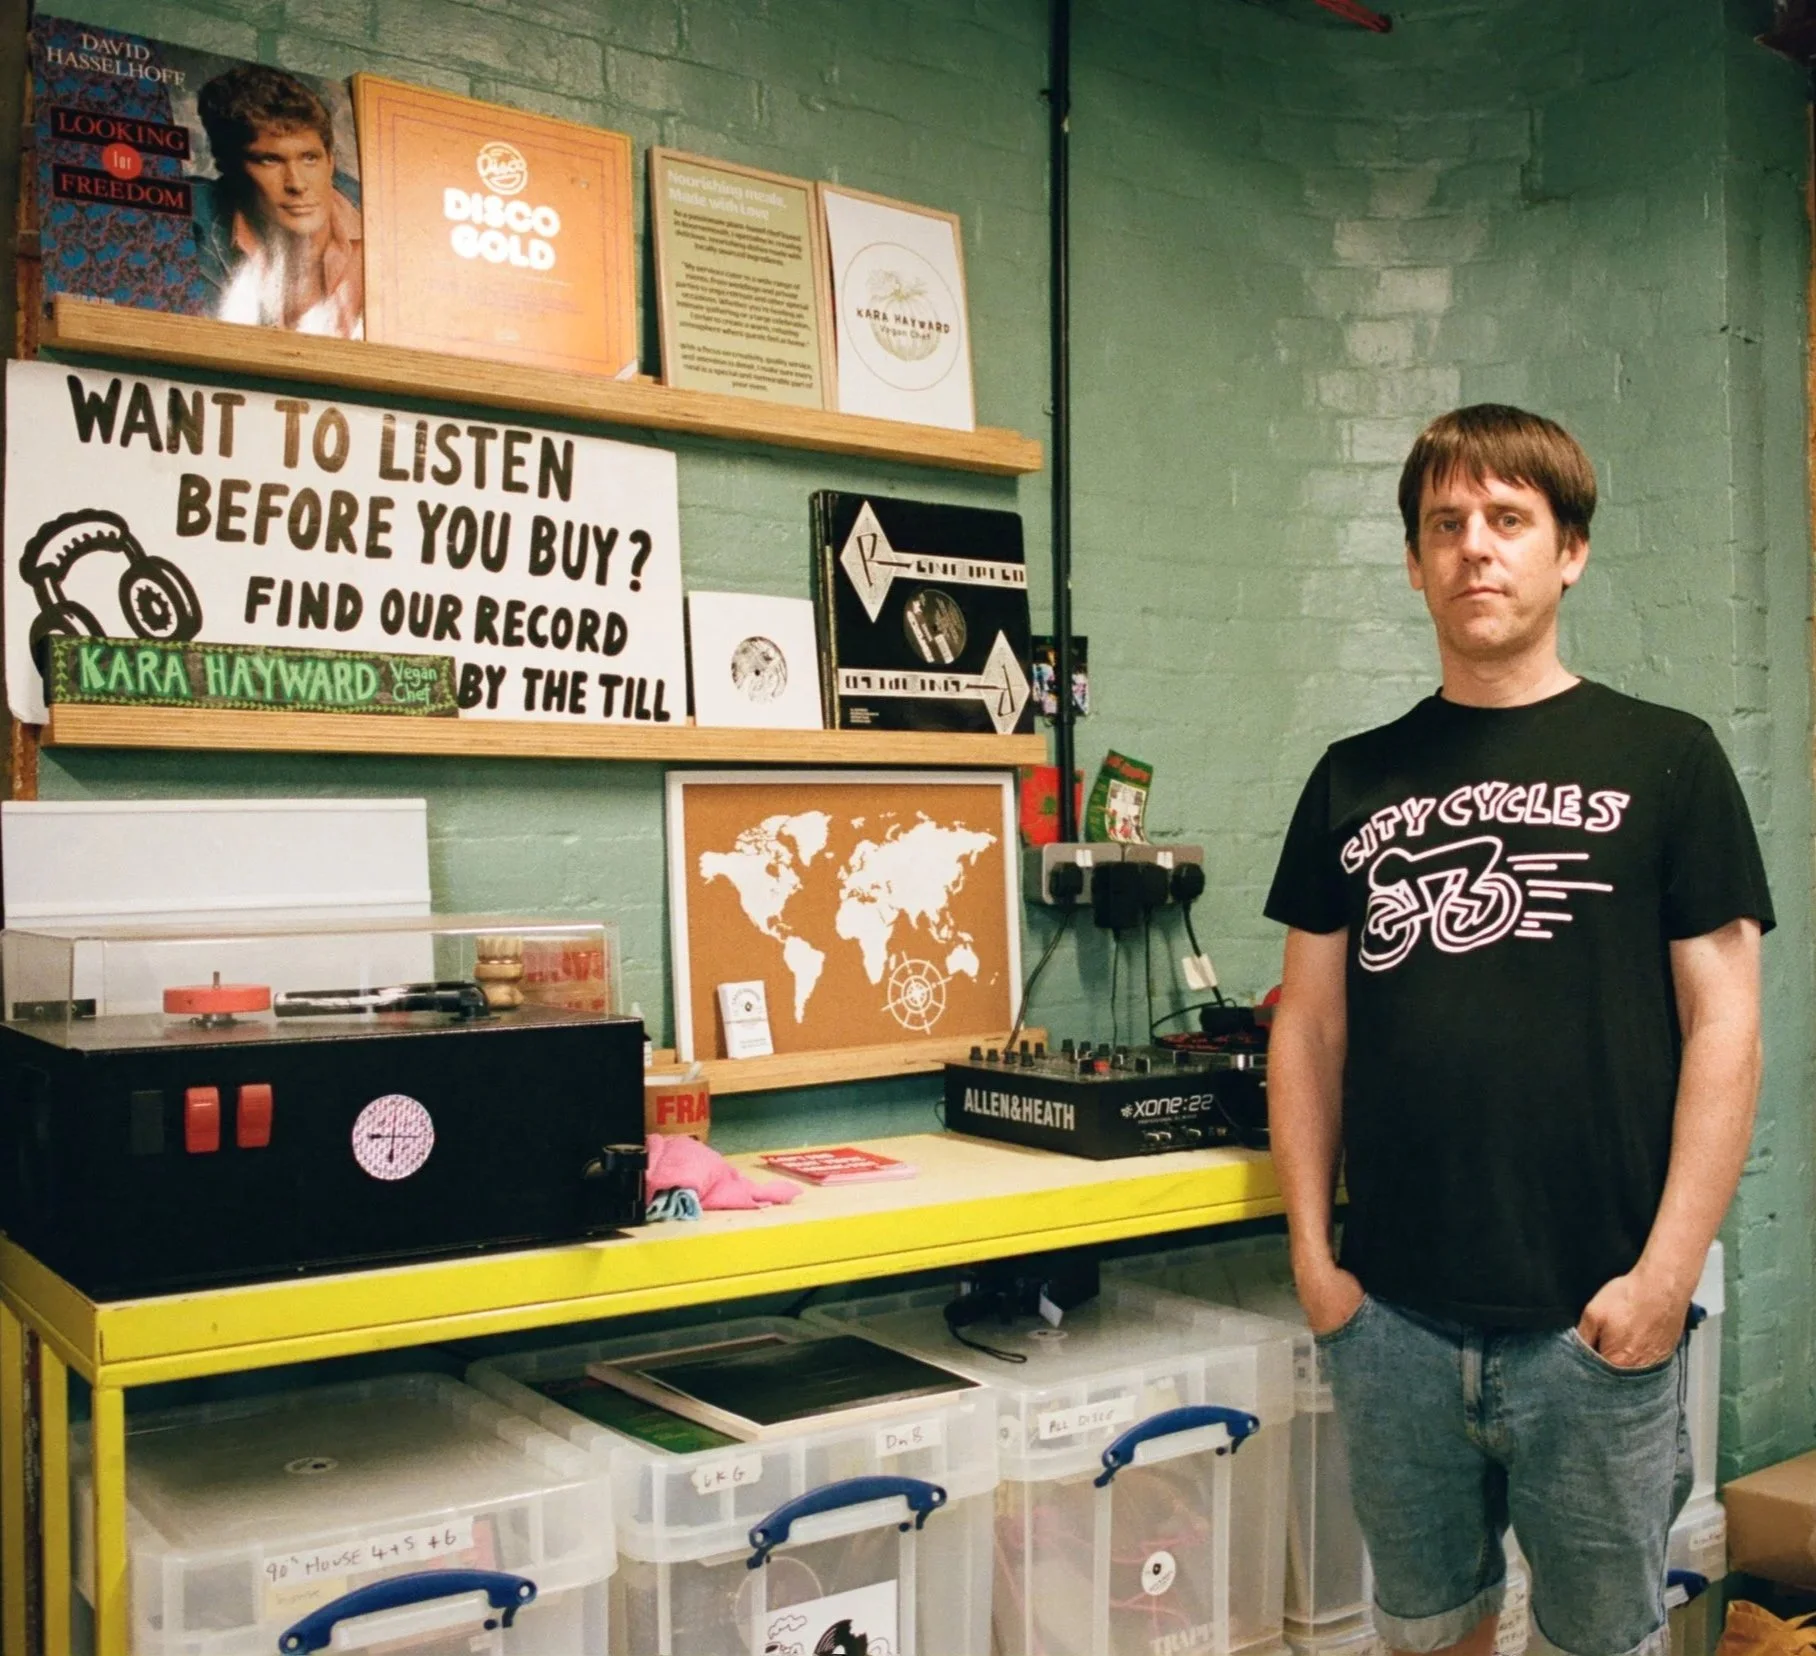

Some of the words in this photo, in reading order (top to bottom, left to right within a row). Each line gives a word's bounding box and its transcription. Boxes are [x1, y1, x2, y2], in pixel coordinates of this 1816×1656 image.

[47, 46, 186, 85] HASSELHOFF
[81, 33, 150, 62] DAVID
[59, 111, 185, 151] LOOKING
[61, 172, 185, 209] FREEDOM
[443, 187, 560, 238] DISCO
[450, 224, 556, 271] GOLD
[856, 308, 888, 322] KARA
[894, 313, 950, 334] HAYWARD
[67, 375, 246, 458] WANT
[274, 400, 350, 473] TO
[379, 413, 574, 502] LISTEN
[176, 473, 395, 559] BEFORE
[417, 500, 511, 573] YOU
[529, 515, 652, 592] BUY?
[244, 576, 363, 632] FIND
[380, 588, 462, 641] OUR
[474, 595, 628, 657] RECORD
[79, 645, 191, 697] KARA
[204, 653, 380, 703] HAYWARD
[389, 658, 438, 688] Vegan
[392, 682, 431, 707] Chef
[457, 663, 506, 710] BY
[522, 667, 588, 715] THE
[598, 673, 671, 723] TILL
[1340, 797, 1436, 874] CITY
[1438, 781, 1630, 832] CYCLES
[964, 1088, 1075, 1131] ALLEN&HEATH
